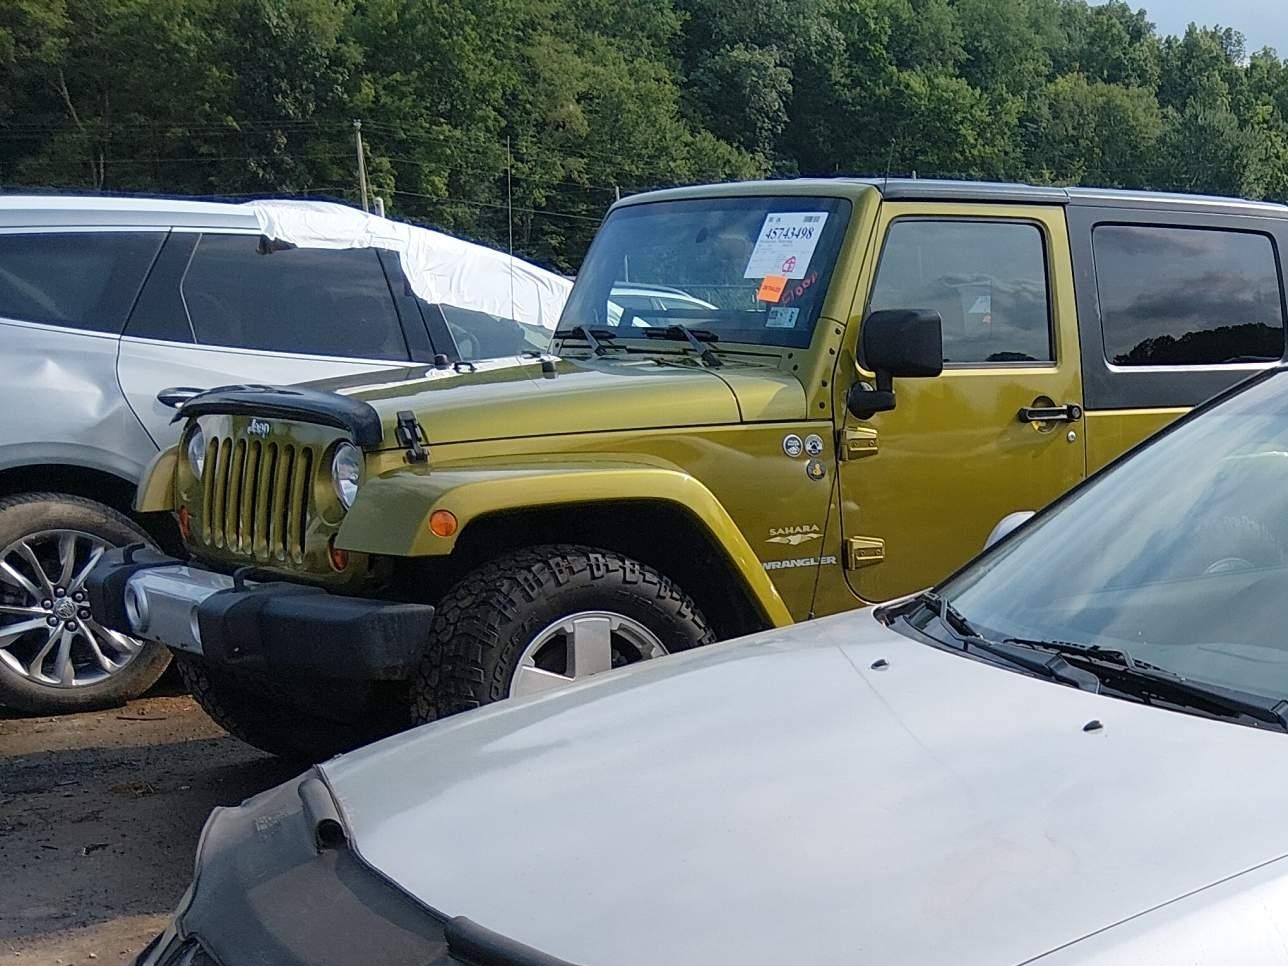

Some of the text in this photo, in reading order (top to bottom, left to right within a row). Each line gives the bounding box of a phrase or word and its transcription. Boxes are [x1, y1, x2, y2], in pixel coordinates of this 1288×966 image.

[765, 226, 815, 240] 45743498
[247, 418, 270, 439] Jeep
[769, 524, 820, 536] SAHARA
[763, 556, 837, 570] WRANGLER
